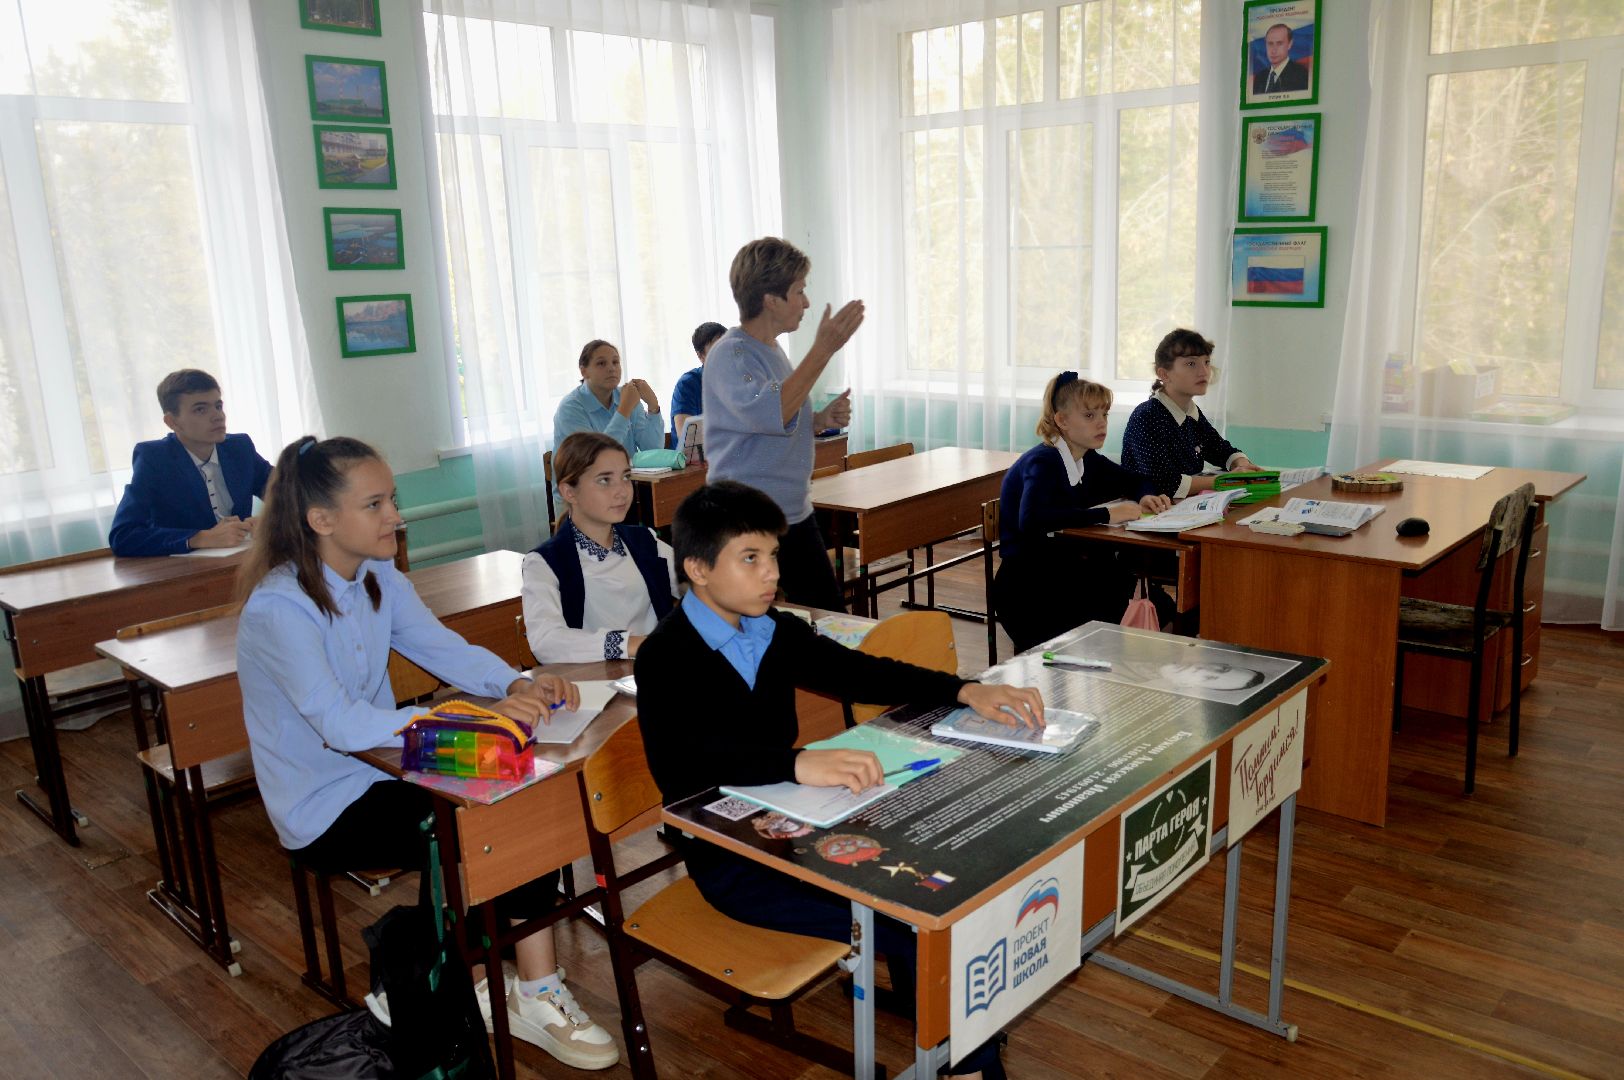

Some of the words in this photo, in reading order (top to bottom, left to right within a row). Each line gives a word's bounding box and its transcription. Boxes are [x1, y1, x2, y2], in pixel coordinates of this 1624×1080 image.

[1102, 755, 1153, 785] Алексей
[1234, 707, 1280, 800] Помним!
[1249, 709, 1299, 808] Гордимся!
[1038, 783, 1109, 824] Иванович
[1134, 822, 1169, 861] ПАРТА
[1169, 796, 1200, 834] ГЕРОЯ
[1013, 917, 1050, 953] ПРОЕКТ
[1013, 937, 1047, 971] НОВАЯ
[1013, 953, 1049, 989] ШКОЛА
